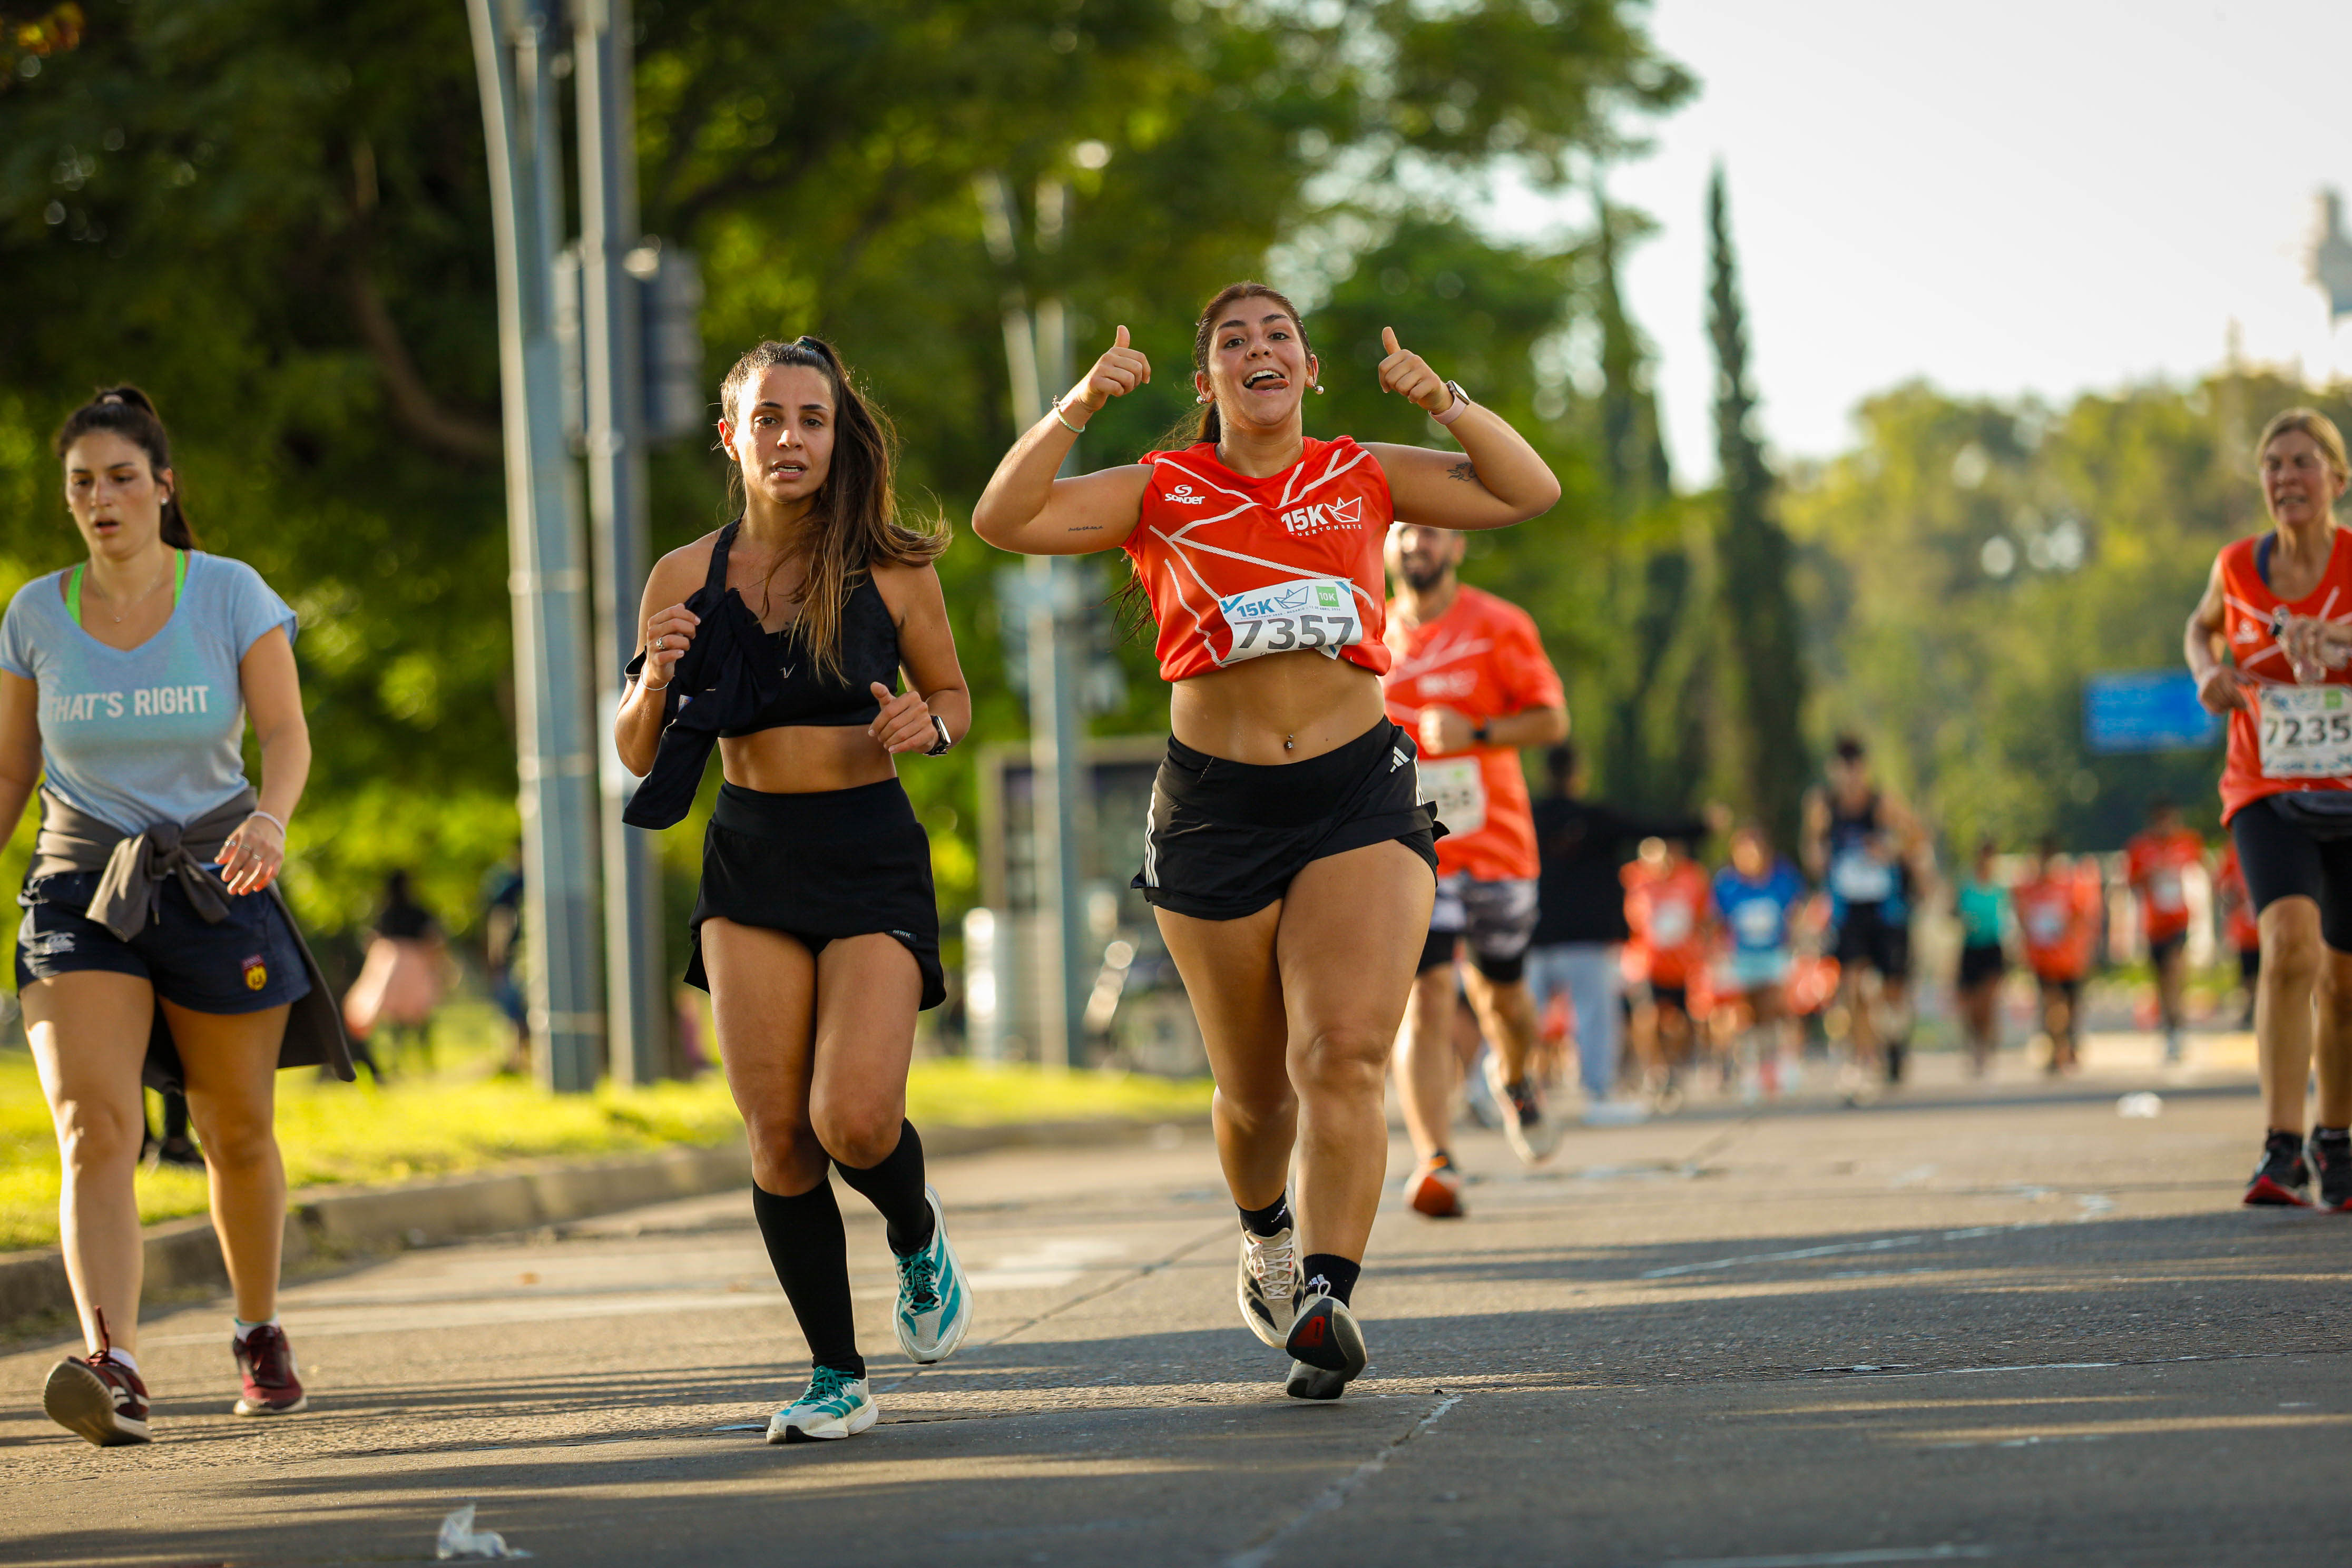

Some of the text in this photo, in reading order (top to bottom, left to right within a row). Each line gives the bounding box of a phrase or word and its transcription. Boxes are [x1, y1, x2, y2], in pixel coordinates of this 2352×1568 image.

[1281, 504, 1329, 532] 15K
[1237, 599, 1275, 617] 15K
[1318, 592, 1336, 601] 10K
[1234, 614, 1354, 650] 7357
[134, 685, 209, 716] RIGHT
[2266, 714, 2350, 746] 7235
